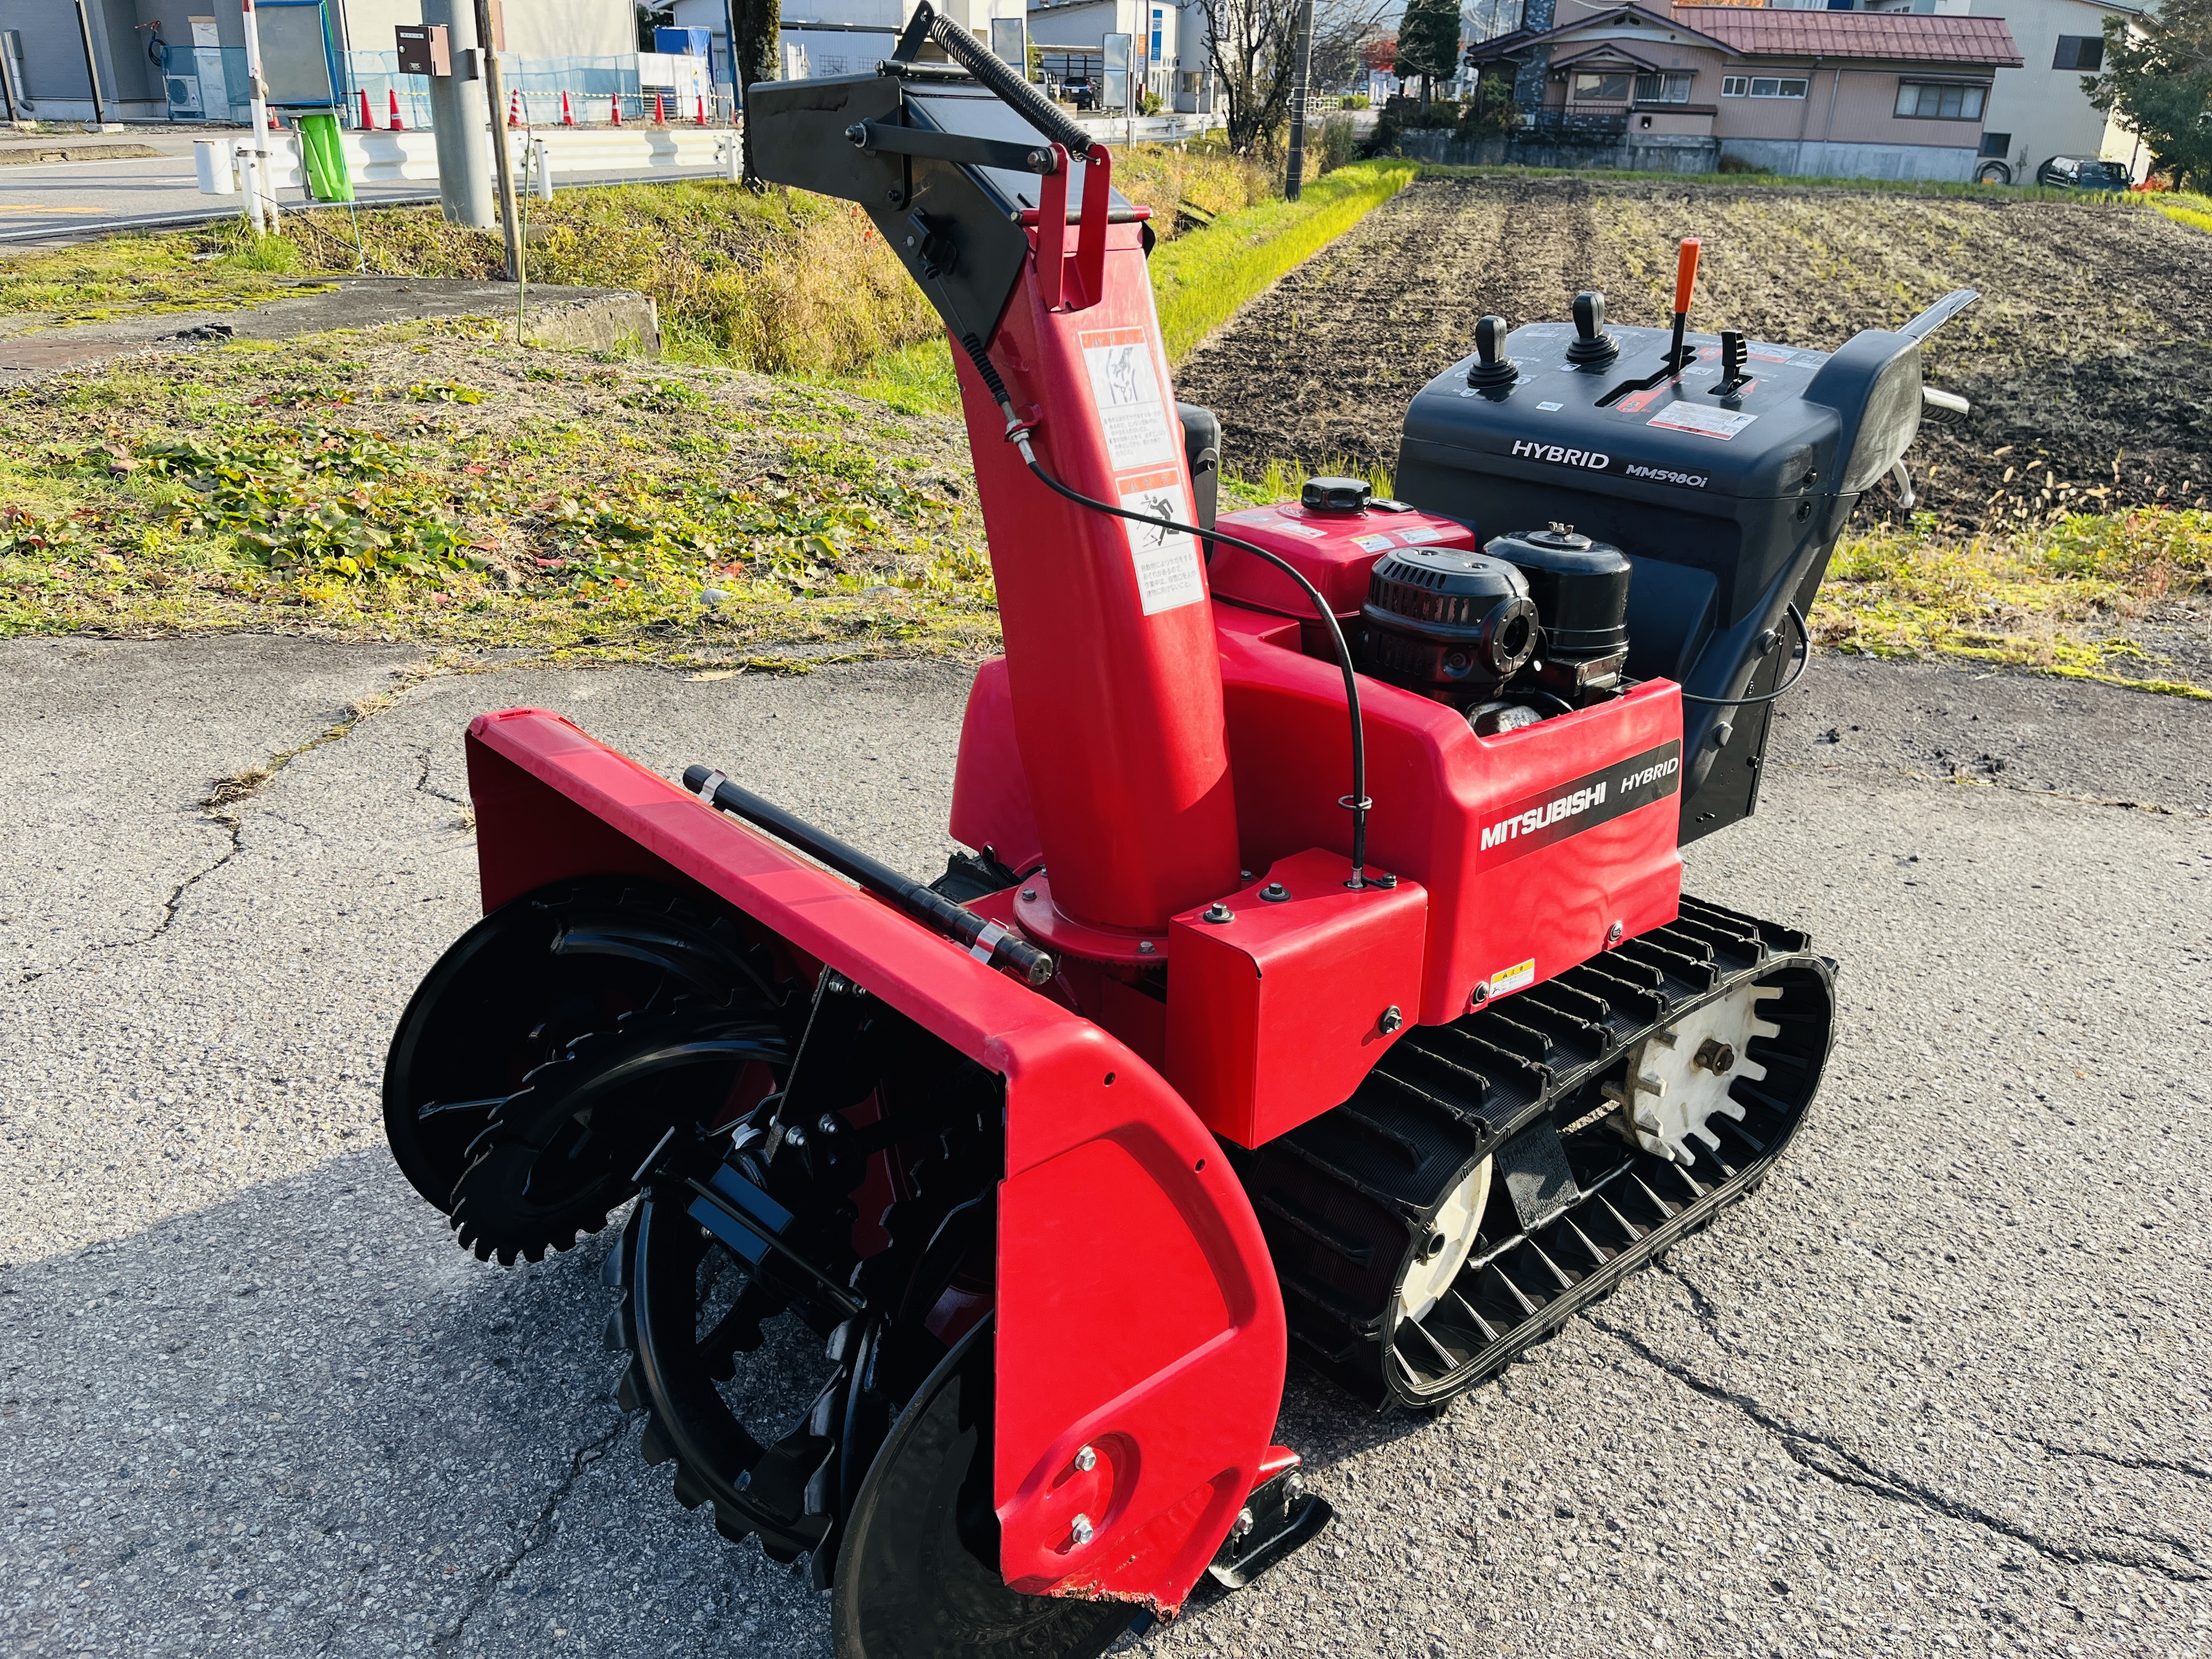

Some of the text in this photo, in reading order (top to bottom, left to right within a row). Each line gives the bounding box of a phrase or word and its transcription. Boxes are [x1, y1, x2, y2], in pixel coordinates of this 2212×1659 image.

[1511, 440, 1708, 488] HYBRID MMS980i
[1481, 757, 1679, 851] MITSUBISHI HYBRID
